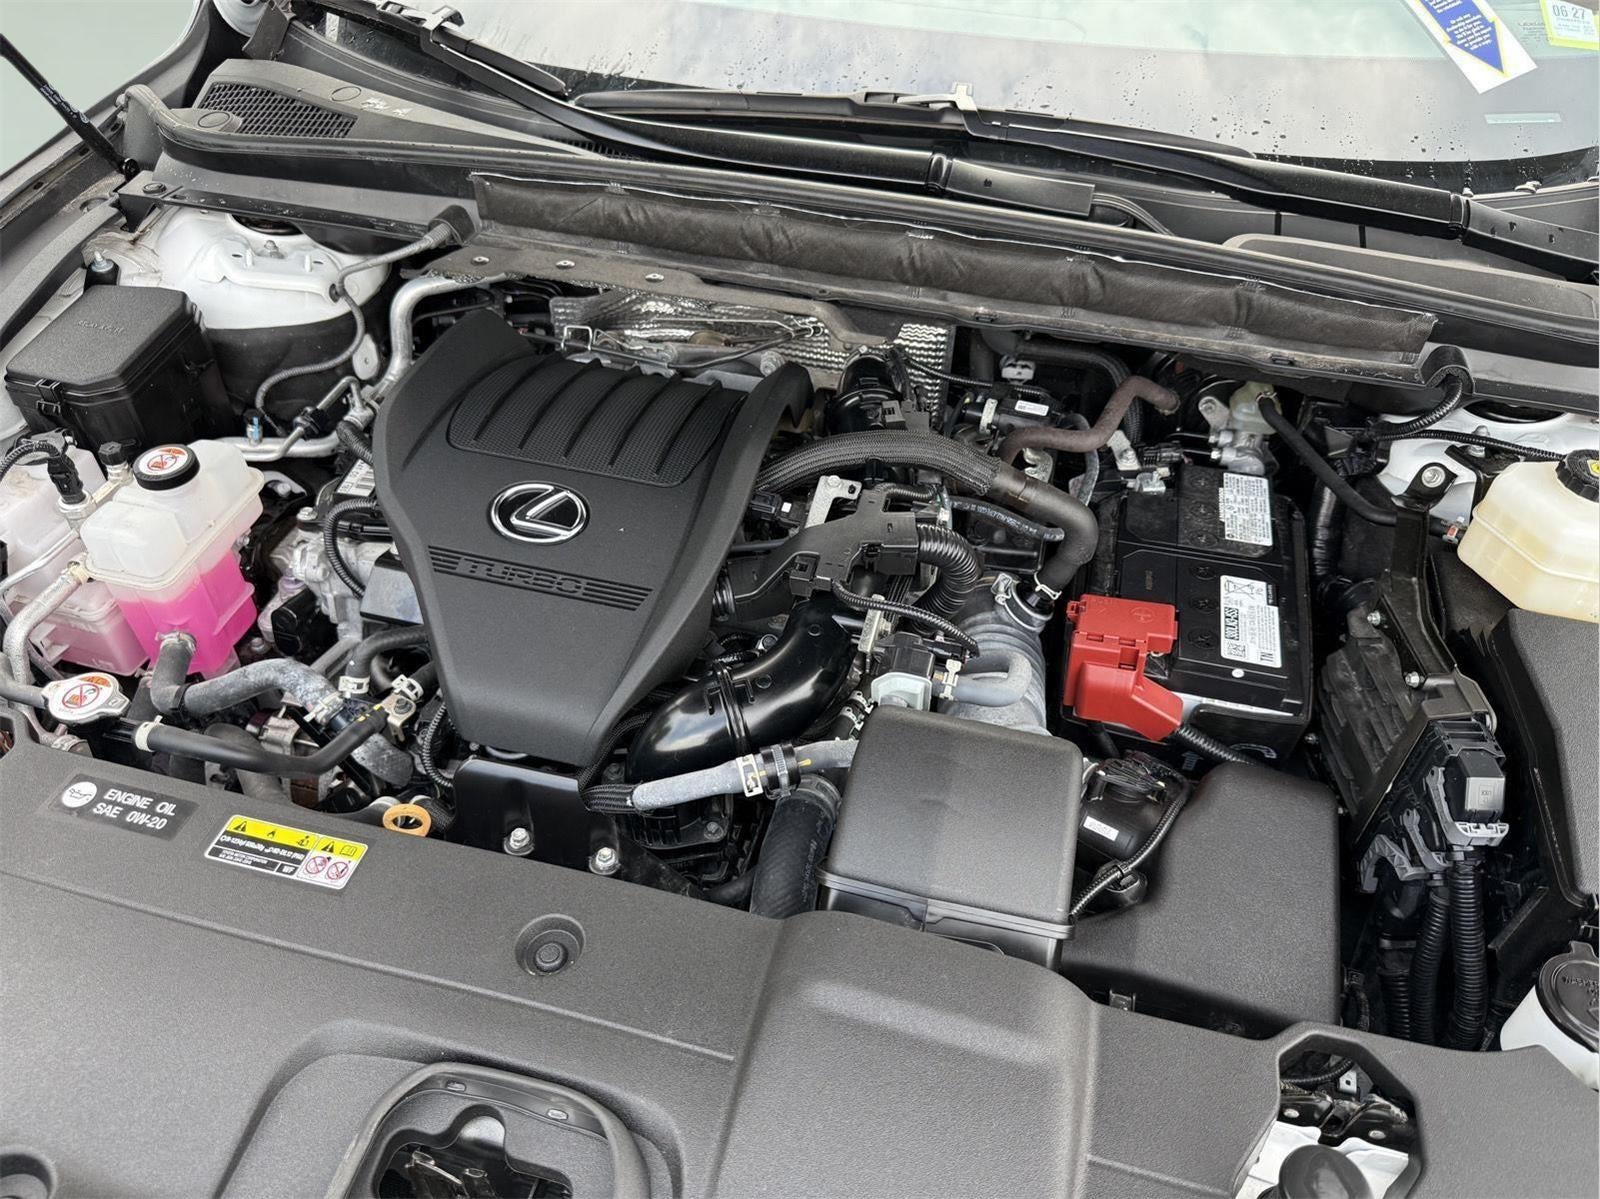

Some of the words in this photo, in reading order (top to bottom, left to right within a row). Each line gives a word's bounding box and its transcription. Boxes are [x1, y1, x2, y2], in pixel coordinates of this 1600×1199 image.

[1552, 4, 1568, 17] 06
[458, 556, 584, 595] TURBO
[92, 802, 124, 818] SAE
[125, 810, 168, 830] 0W-20
[103, 788, 154, 809] ENGINE
[155, 801, 177, 816] OIL
